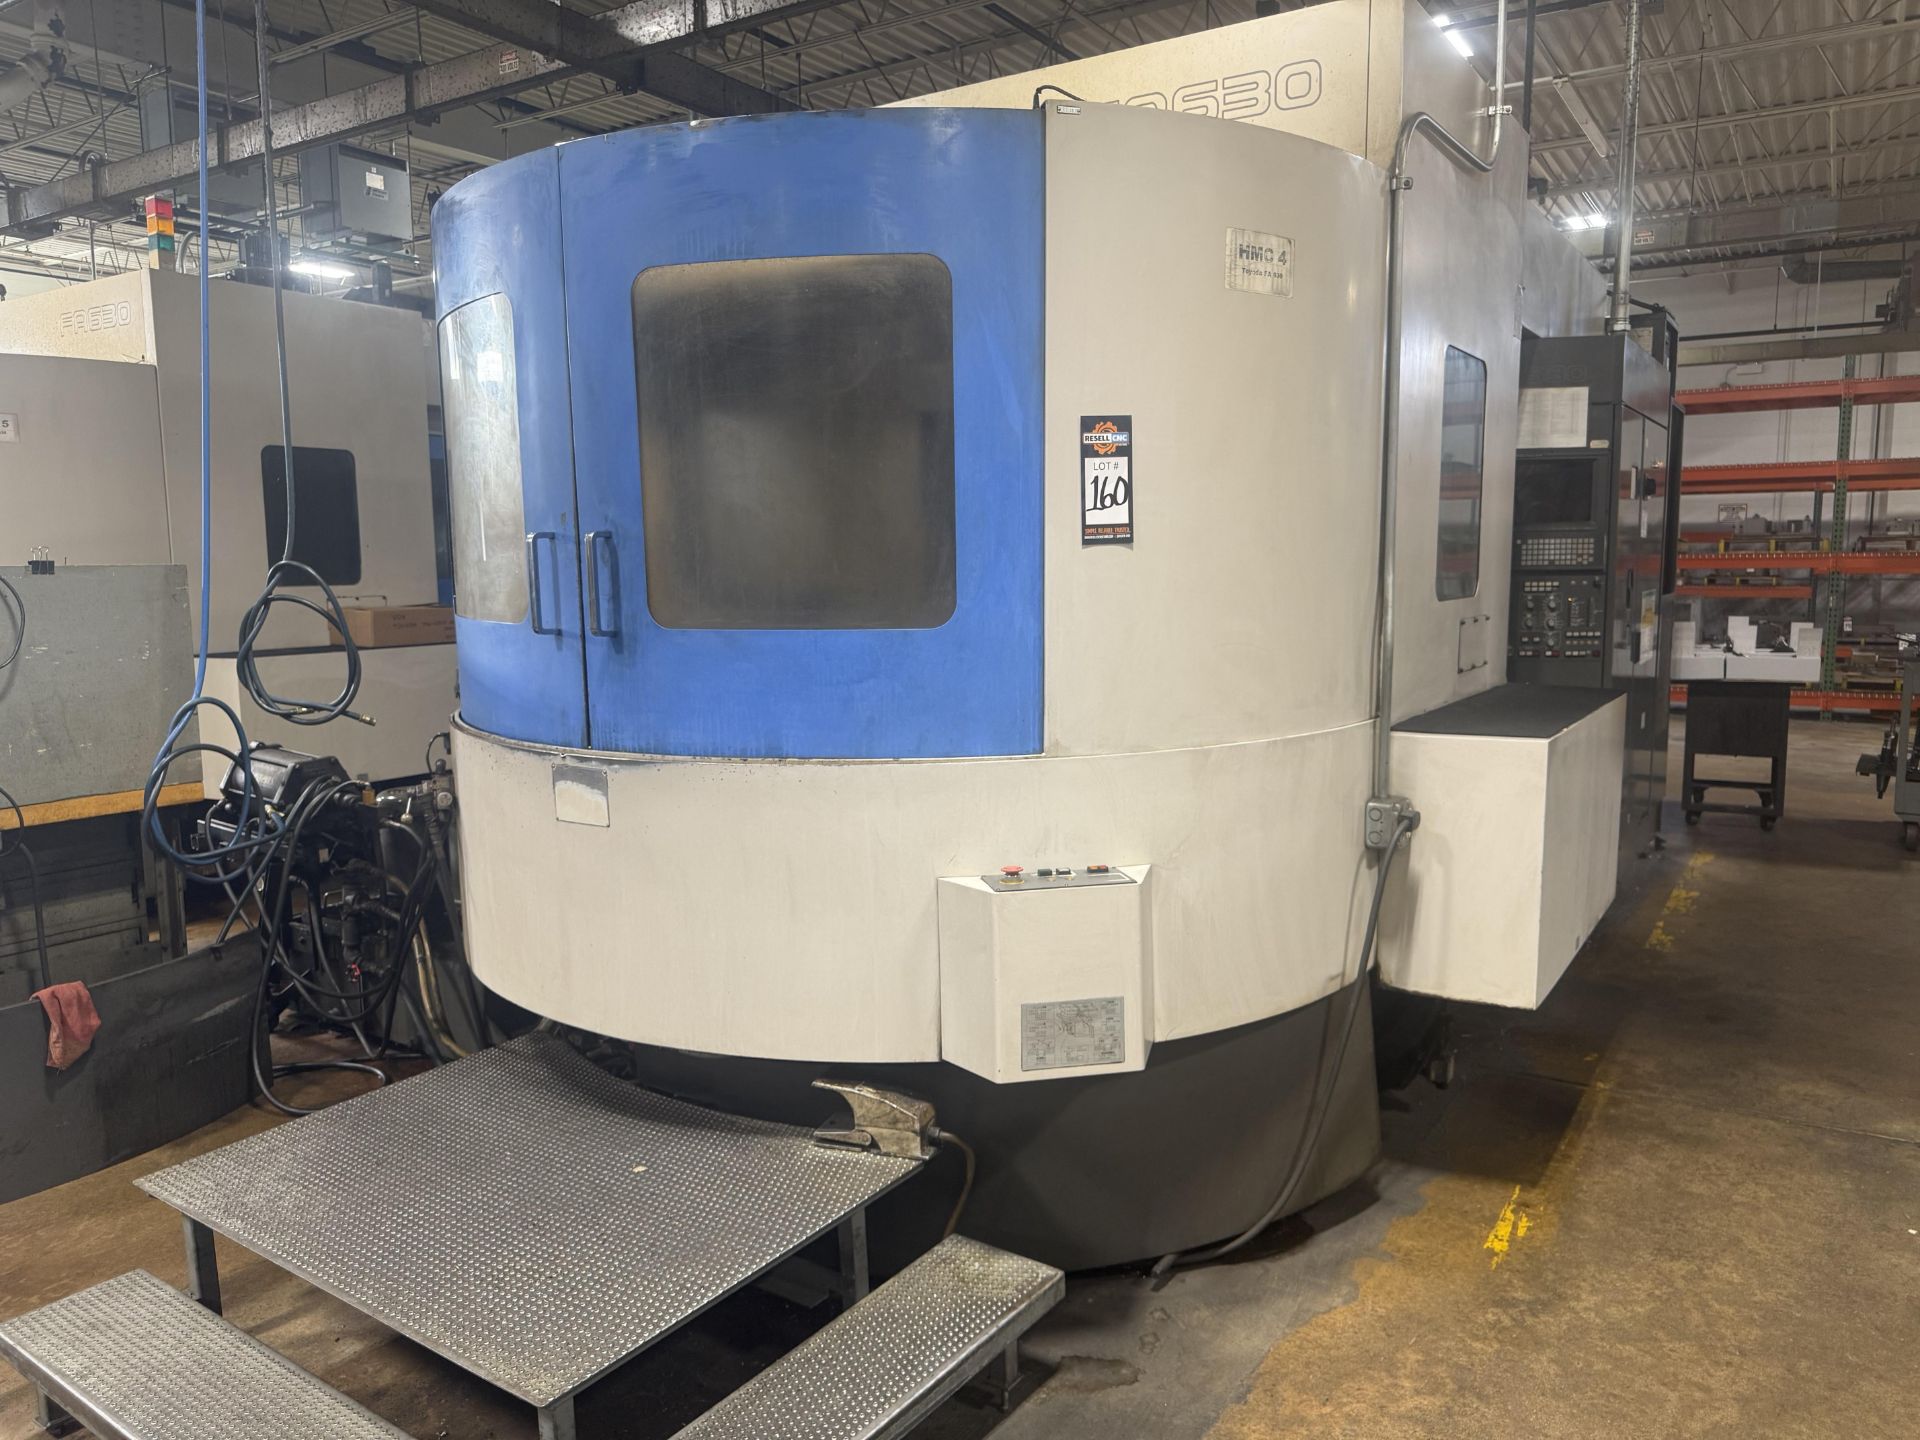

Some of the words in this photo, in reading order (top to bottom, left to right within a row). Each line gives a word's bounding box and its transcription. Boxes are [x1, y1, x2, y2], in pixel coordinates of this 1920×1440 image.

[1239, 244, 1274, 263] HMC
[1278, 250, 1287, 265] 4
[60, 301, 131, 337] FA630
[1093, 462, 1111, 471] LOT
[1113, 461, 1119, 470] #
[1086, 475, 1129, 511] 160
